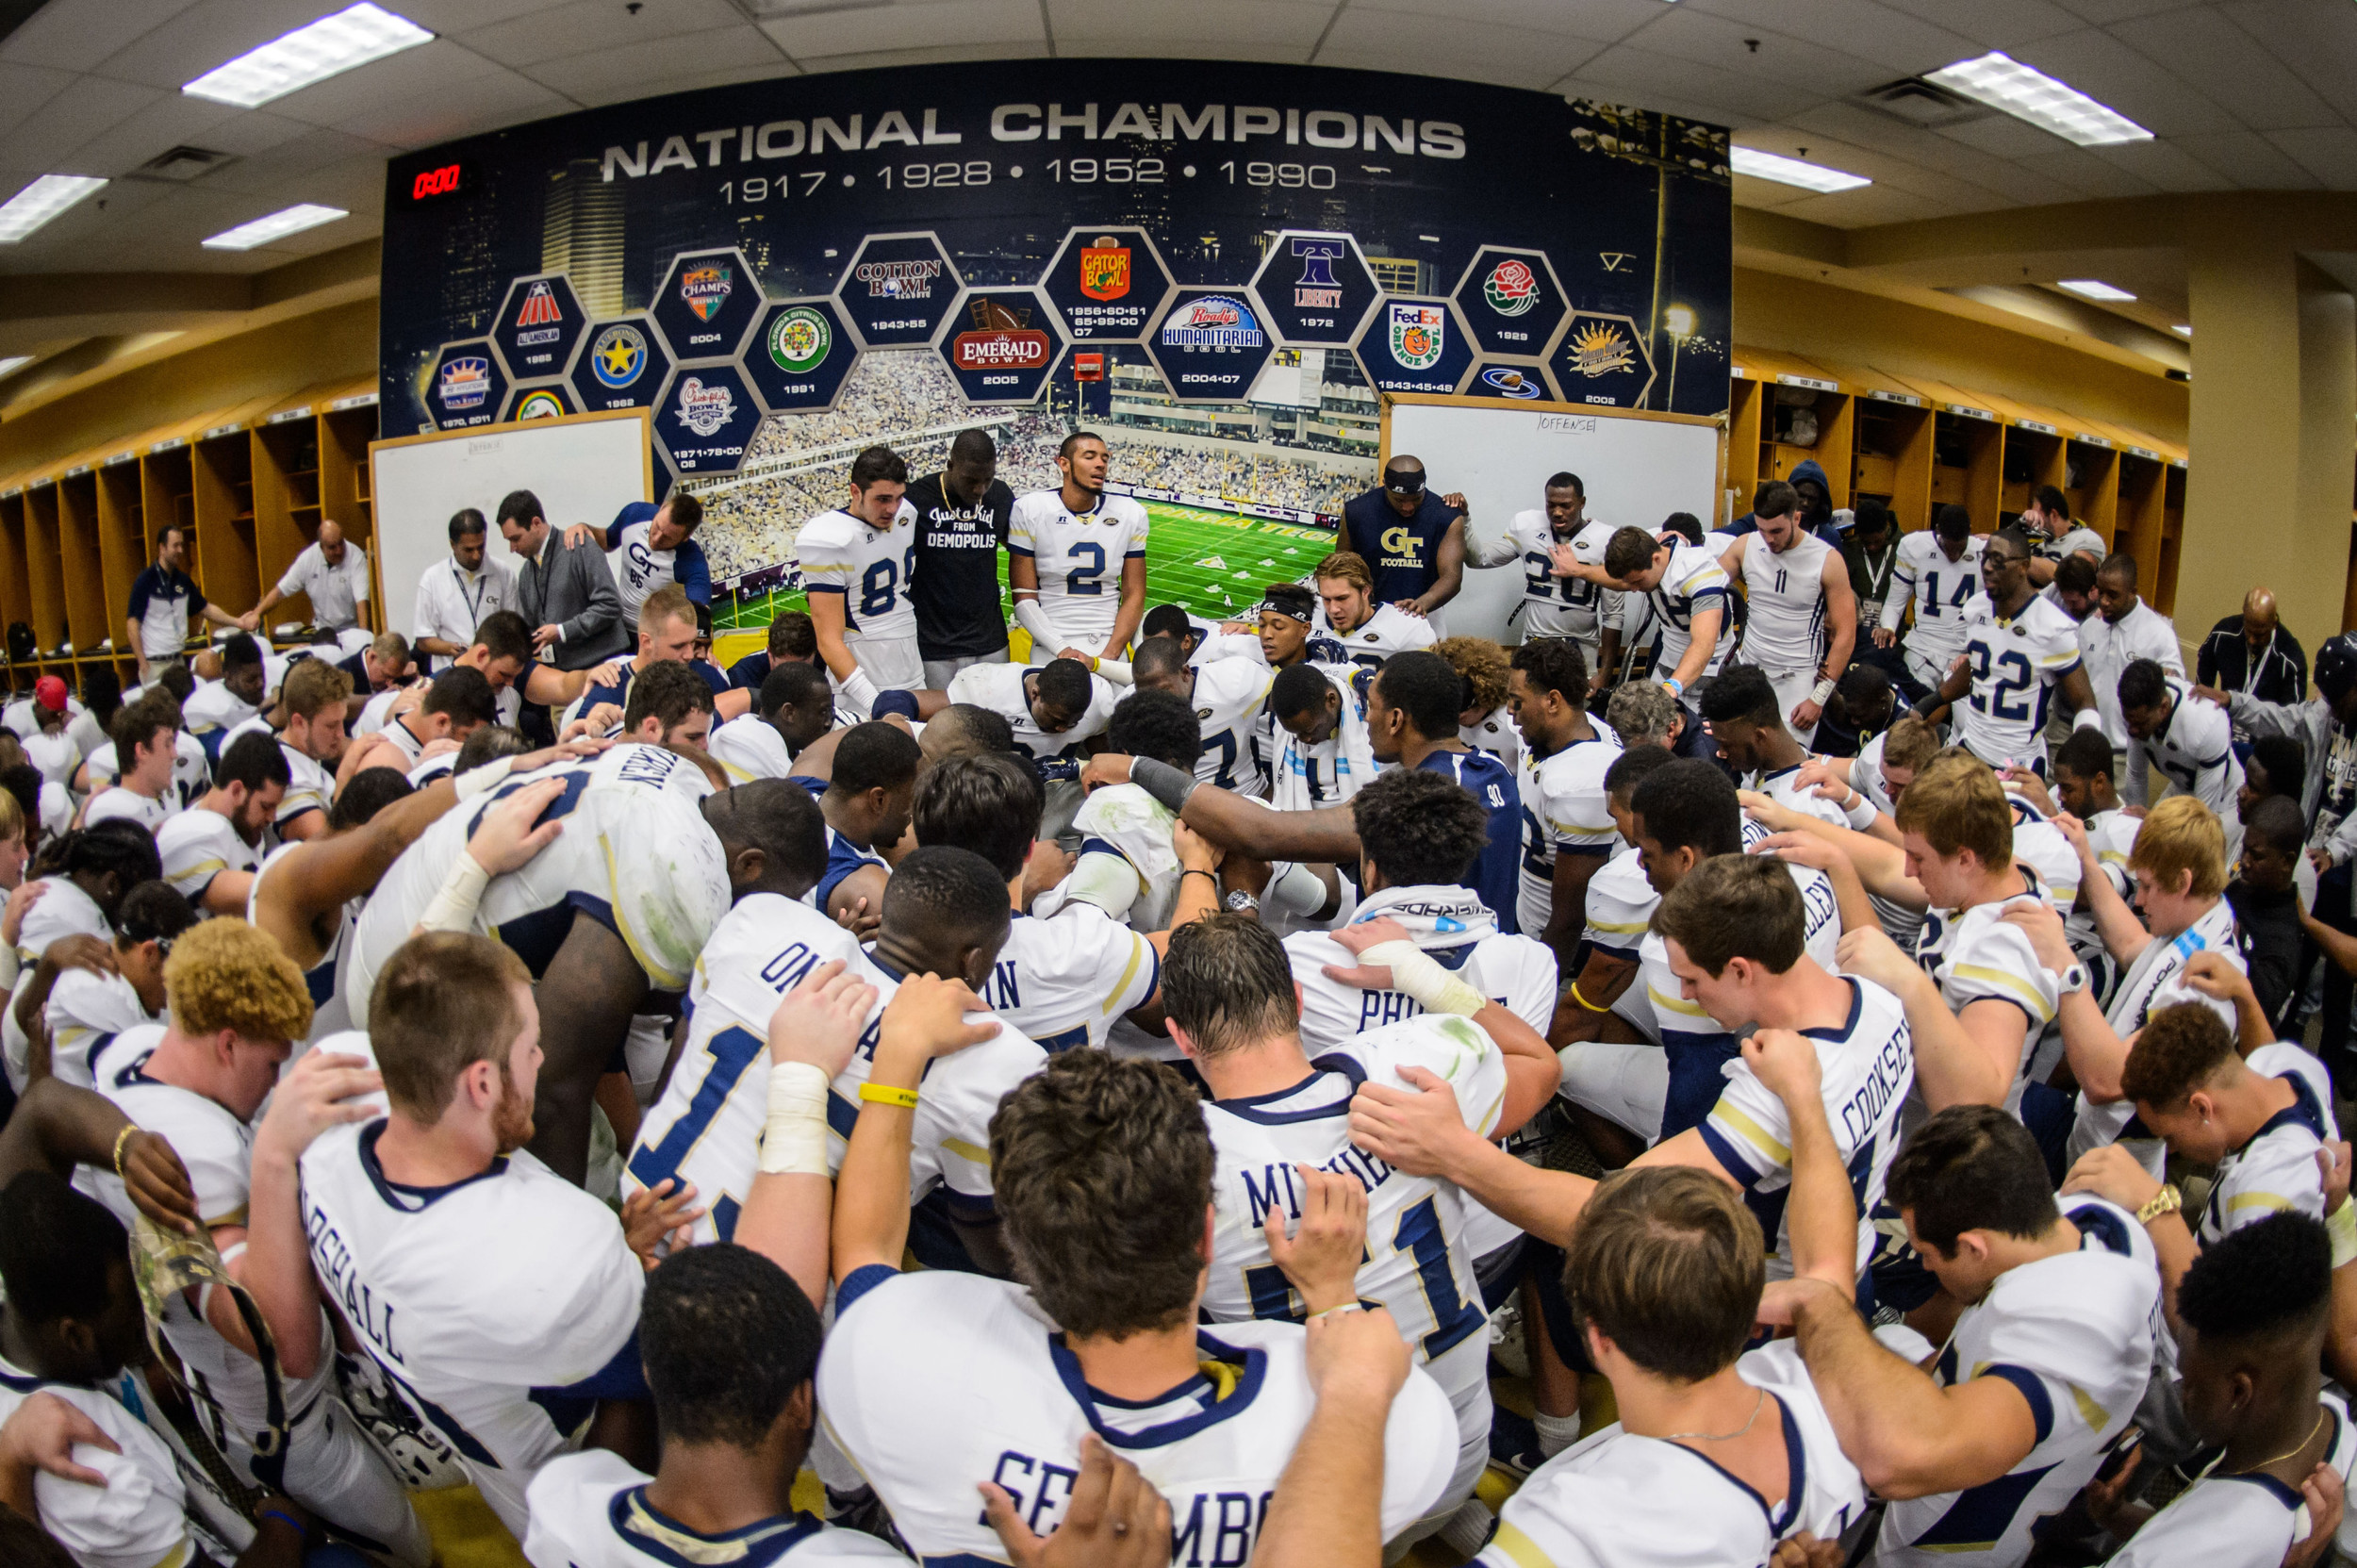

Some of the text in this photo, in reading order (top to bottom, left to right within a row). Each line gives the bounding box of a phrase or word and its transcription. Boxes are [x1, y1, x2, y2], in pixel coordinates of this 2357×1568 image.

[602, 104, 1467, 182] NATIONAL CHAMPIONS
[413, 165, 460, 199] 0:00
[719, 158, 1337, 206] 1917 1928 1952 1990
[856, 260, 942, 282] COTTON
[1082, 255, 1129, 272] GATOR
[869, 278, 931, 297] BOWL
[1086, 271, 1125, 288] BOWL
[682, 281, 733, 298] CHAMPS
[692, 296, 720, 305] BOWL
[1294, 289, 1343, 308] LIBERTY
[1190, 306, 1240, 324] Roady's
[1300, 318, 1334, 328] 1972
[1393, 308, 1441, 325] FedEx
[690, 334, 721, 344] 2004
[772, 310, 831, 351] FLORIDA CITRUS BOWL
[1074, 328, 1093, 337] 07
[1162, 328, 1263, 347] HUMANITARIAN
[1497, 331, 1528, 340] 1929
[963, 340, 1042, 361] EMERALD
[1183, 345, 1241, 354] BOWL
[1393, 326, 1422, 366] ORANGE
[1426, 328, 1441, 363] BOWL
[1605, 340, 1627, 355] Valley
[977, 355, 1027, 364] BOWL
[783, 384, 816, 394] 1991
[983, 376, 1019, 385] 2005
[606, 399, 635, 409] 1962
[1586, 395, 1615, 405] 2002
[688, 404, 724, 414] BOWL
[469, 415, 491, 424] 2011
[1541, 417, 1594, 433] OFFENSE
[681, 459, 697, 469] 08
[930, 507, 954, 529] Just
[974, 506, 995, 530] Kid
[953, 521, 976, 532] FROM
[927, 533, 997, 549] DEMOPOLIS
[1380, 526, 1424, 558] GT
[629, 542, 660, 578] GT
[1065, 541, 1106, 596] 2
[1380, 558, 1424, 568] FOOTBALL
[1774, 569, 1788, 594] 11
[1922, 570, 1976, 620] 14
[1967, 639, 2033, 721] 22
[1487, 784, 1505, 808] 90
[1393, 902, 1497, 920] OWERADE
[306, 1197, 404, 1366] RSHALL
